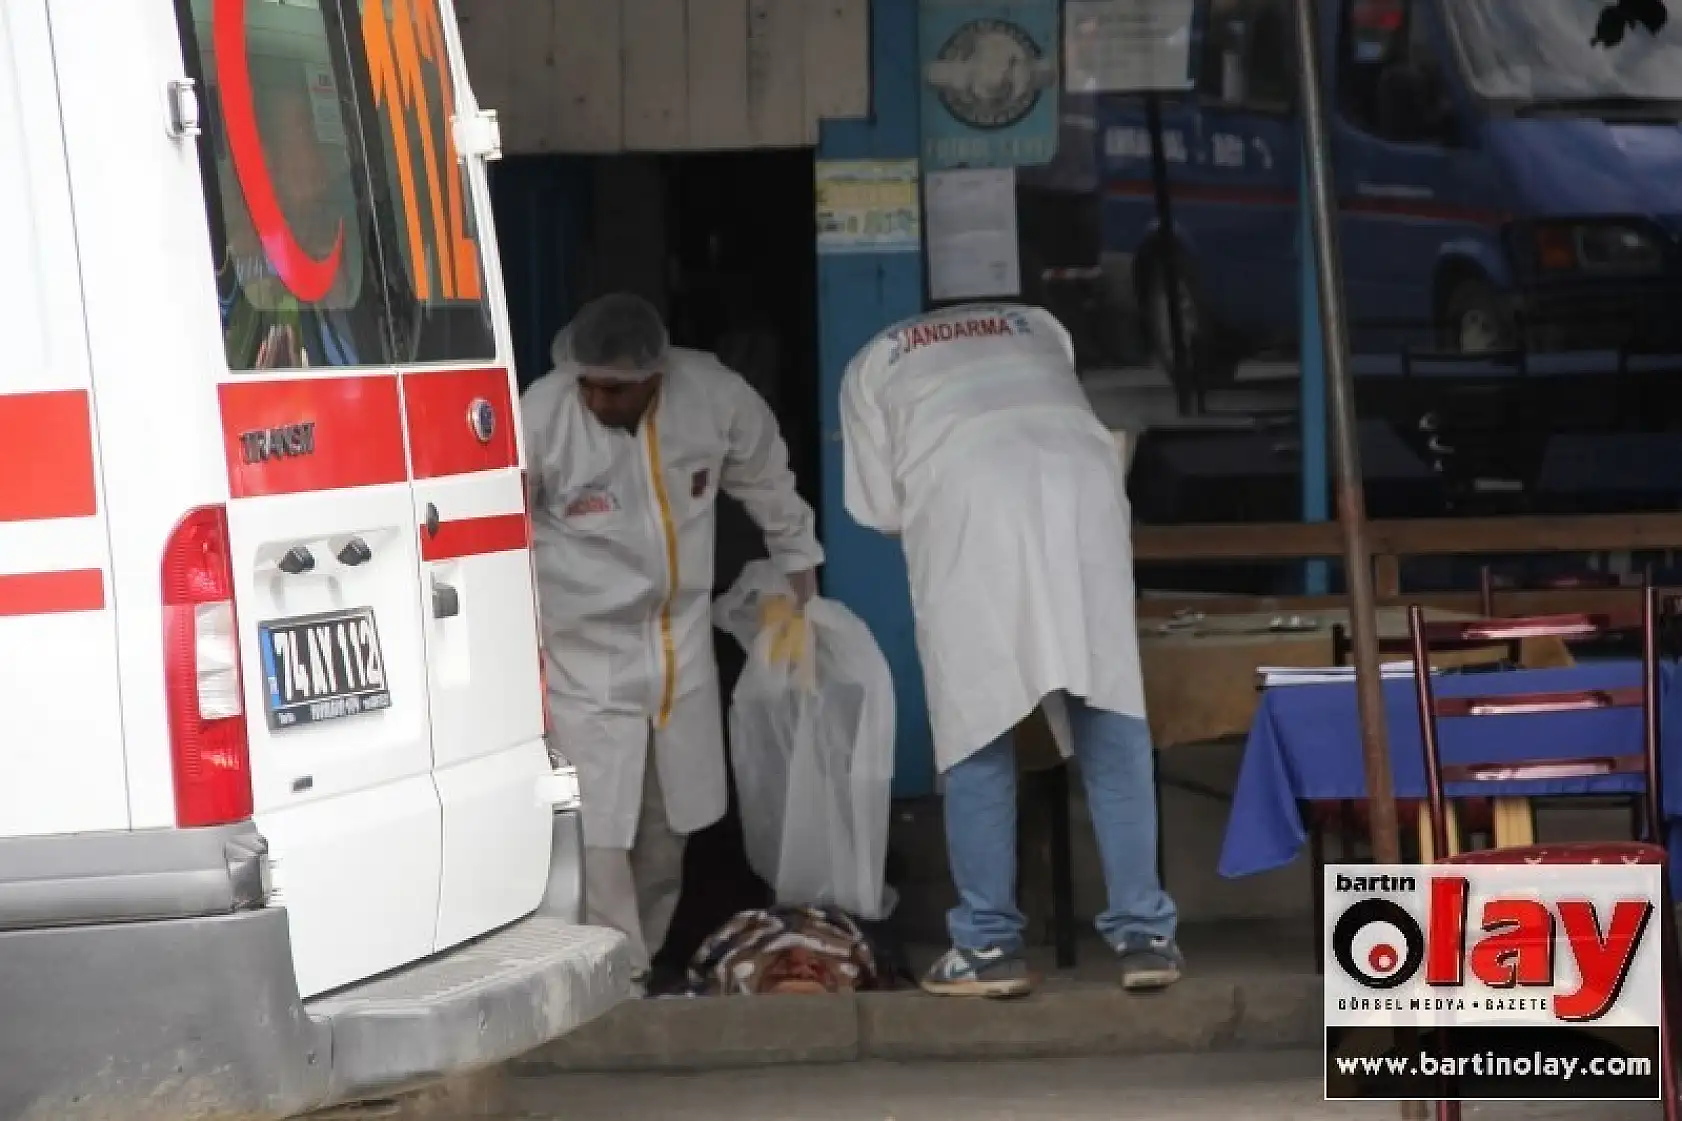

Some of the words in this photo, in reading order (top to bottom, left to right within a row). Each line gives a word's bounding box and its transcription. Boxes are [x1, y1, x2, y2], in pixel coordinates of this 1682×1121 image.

[903, 316, 1013, 353] JANDARMA
[273, 630, 309, 701] 74
[307, 625, 337, 695] AY
[337, 619, 386, 691] 112
